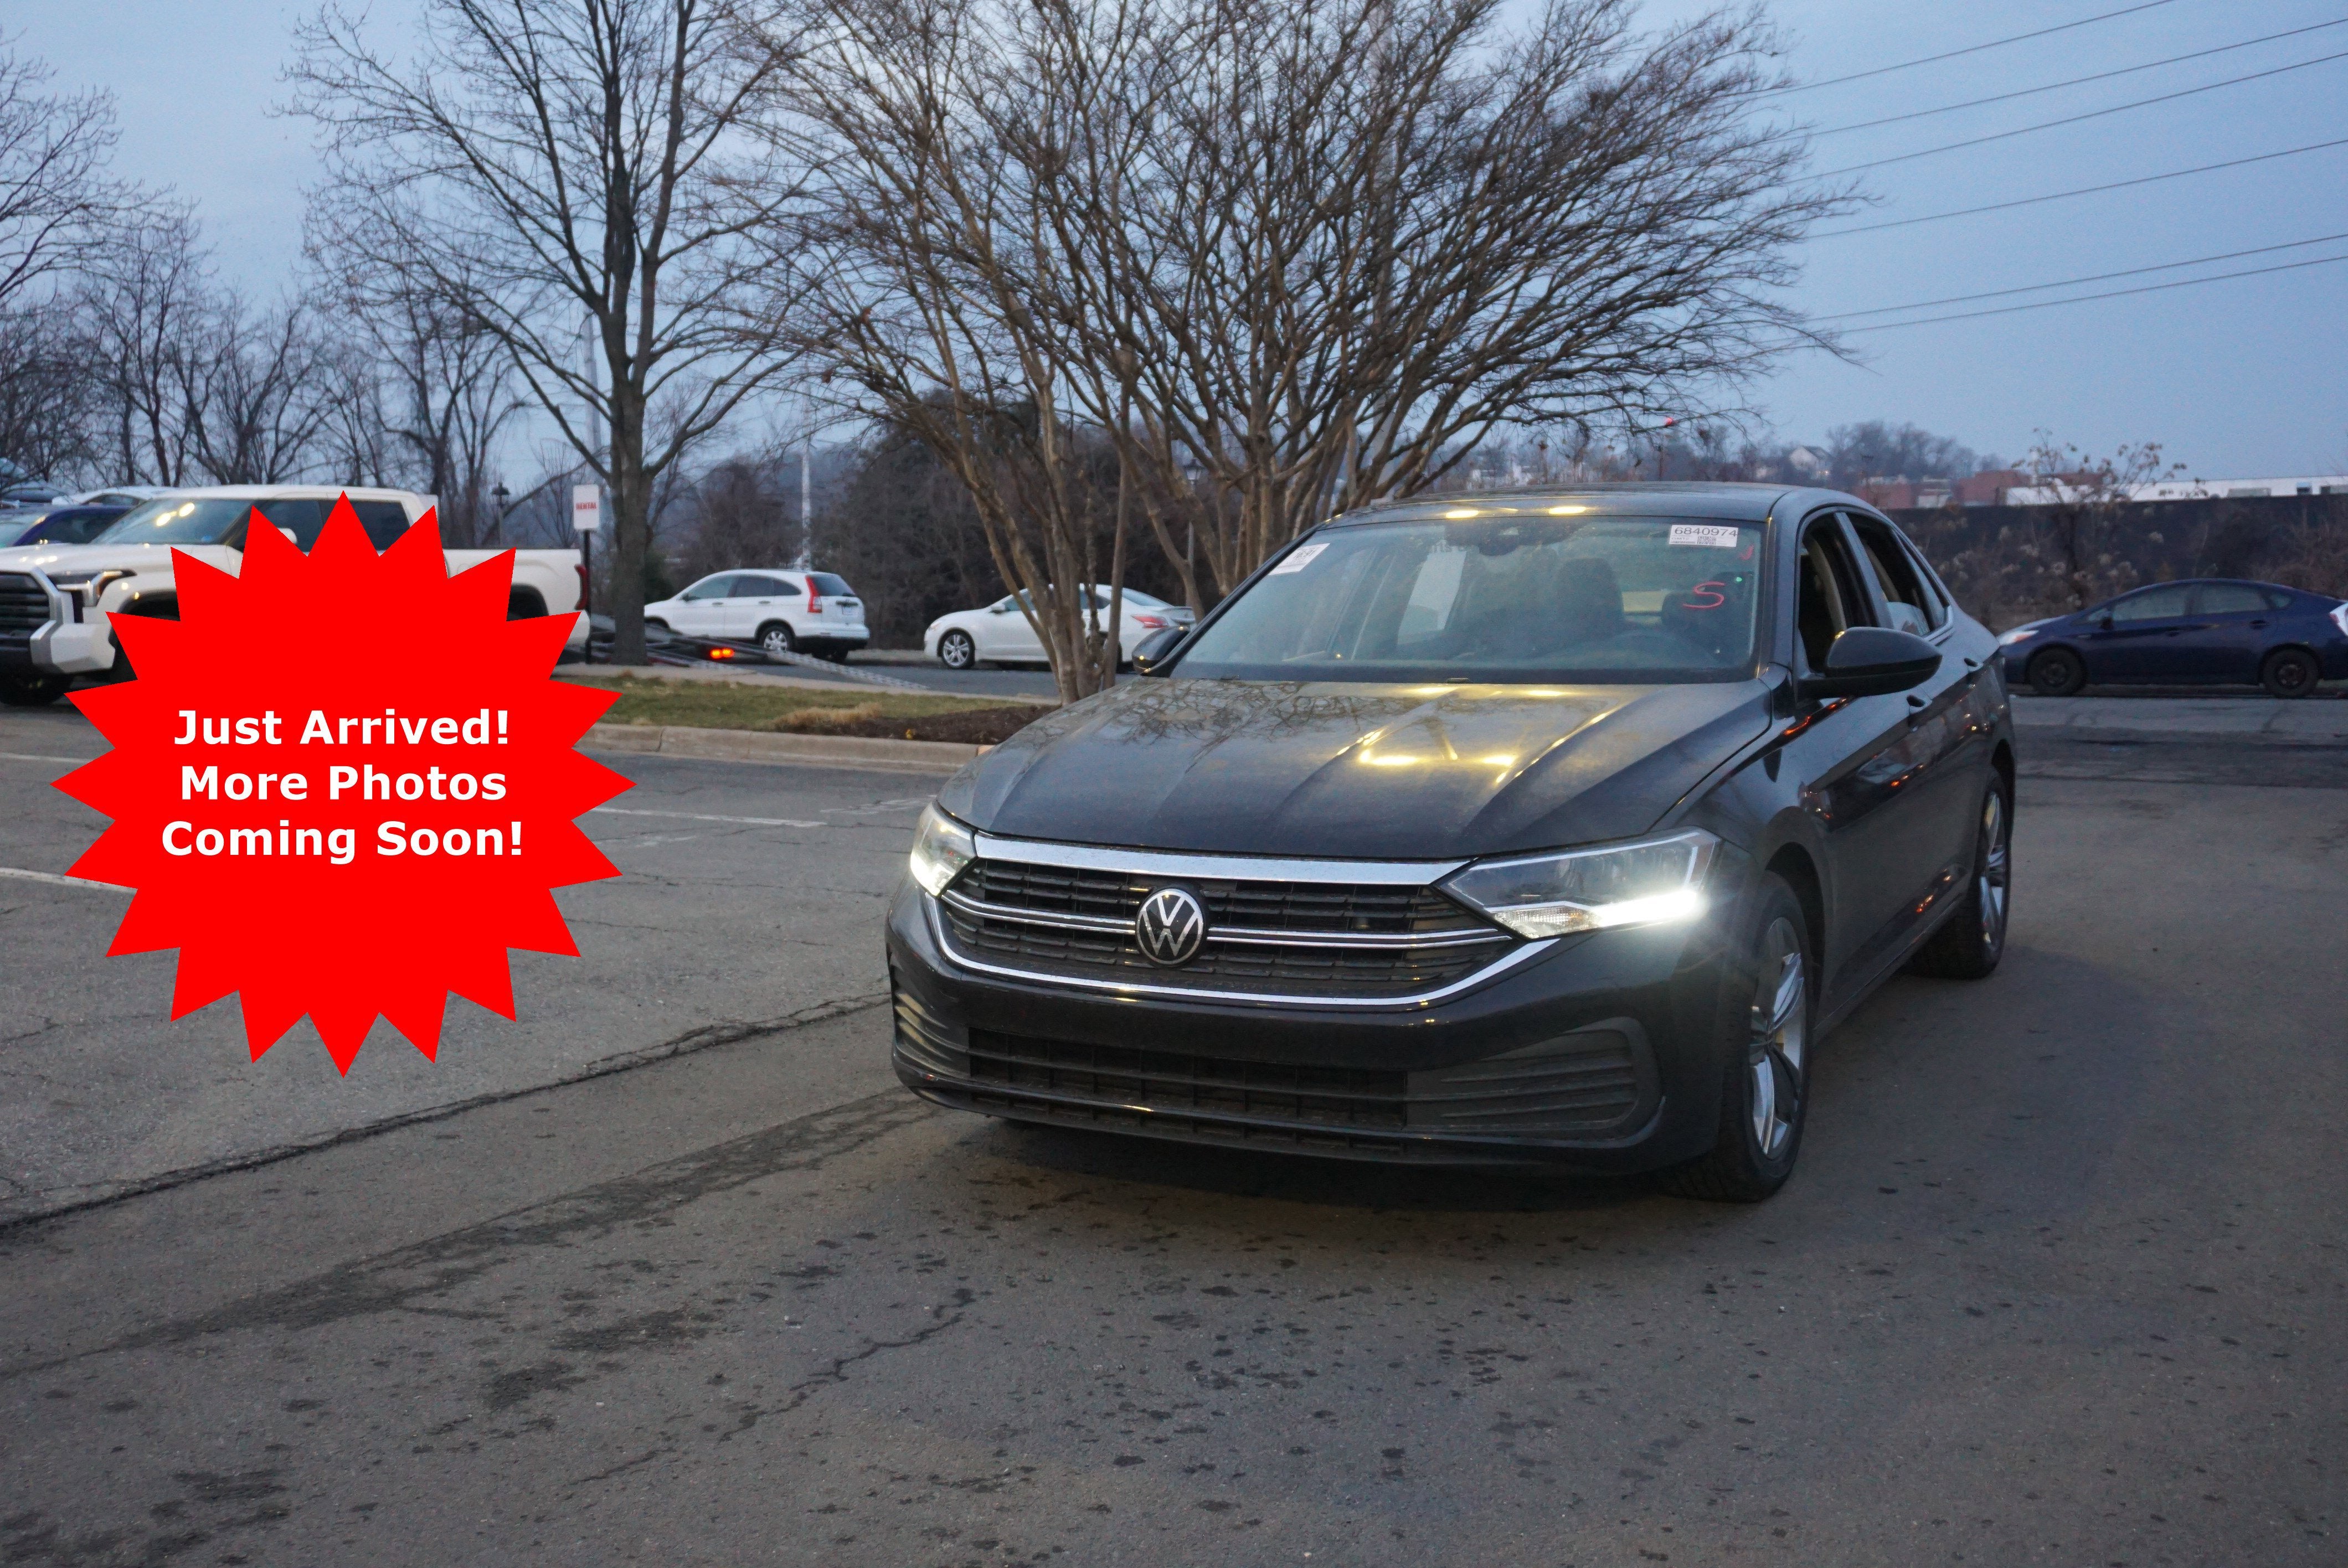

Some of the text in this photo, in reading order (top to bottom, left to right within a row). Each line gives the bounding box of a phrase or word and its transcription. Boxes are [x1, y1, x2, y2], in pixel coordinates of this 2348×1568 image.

[576, 502, 597, 510] RENTAL
[1674, 527, 1738, 537] 6840974
[1136, 888, 1204, 965] VW
